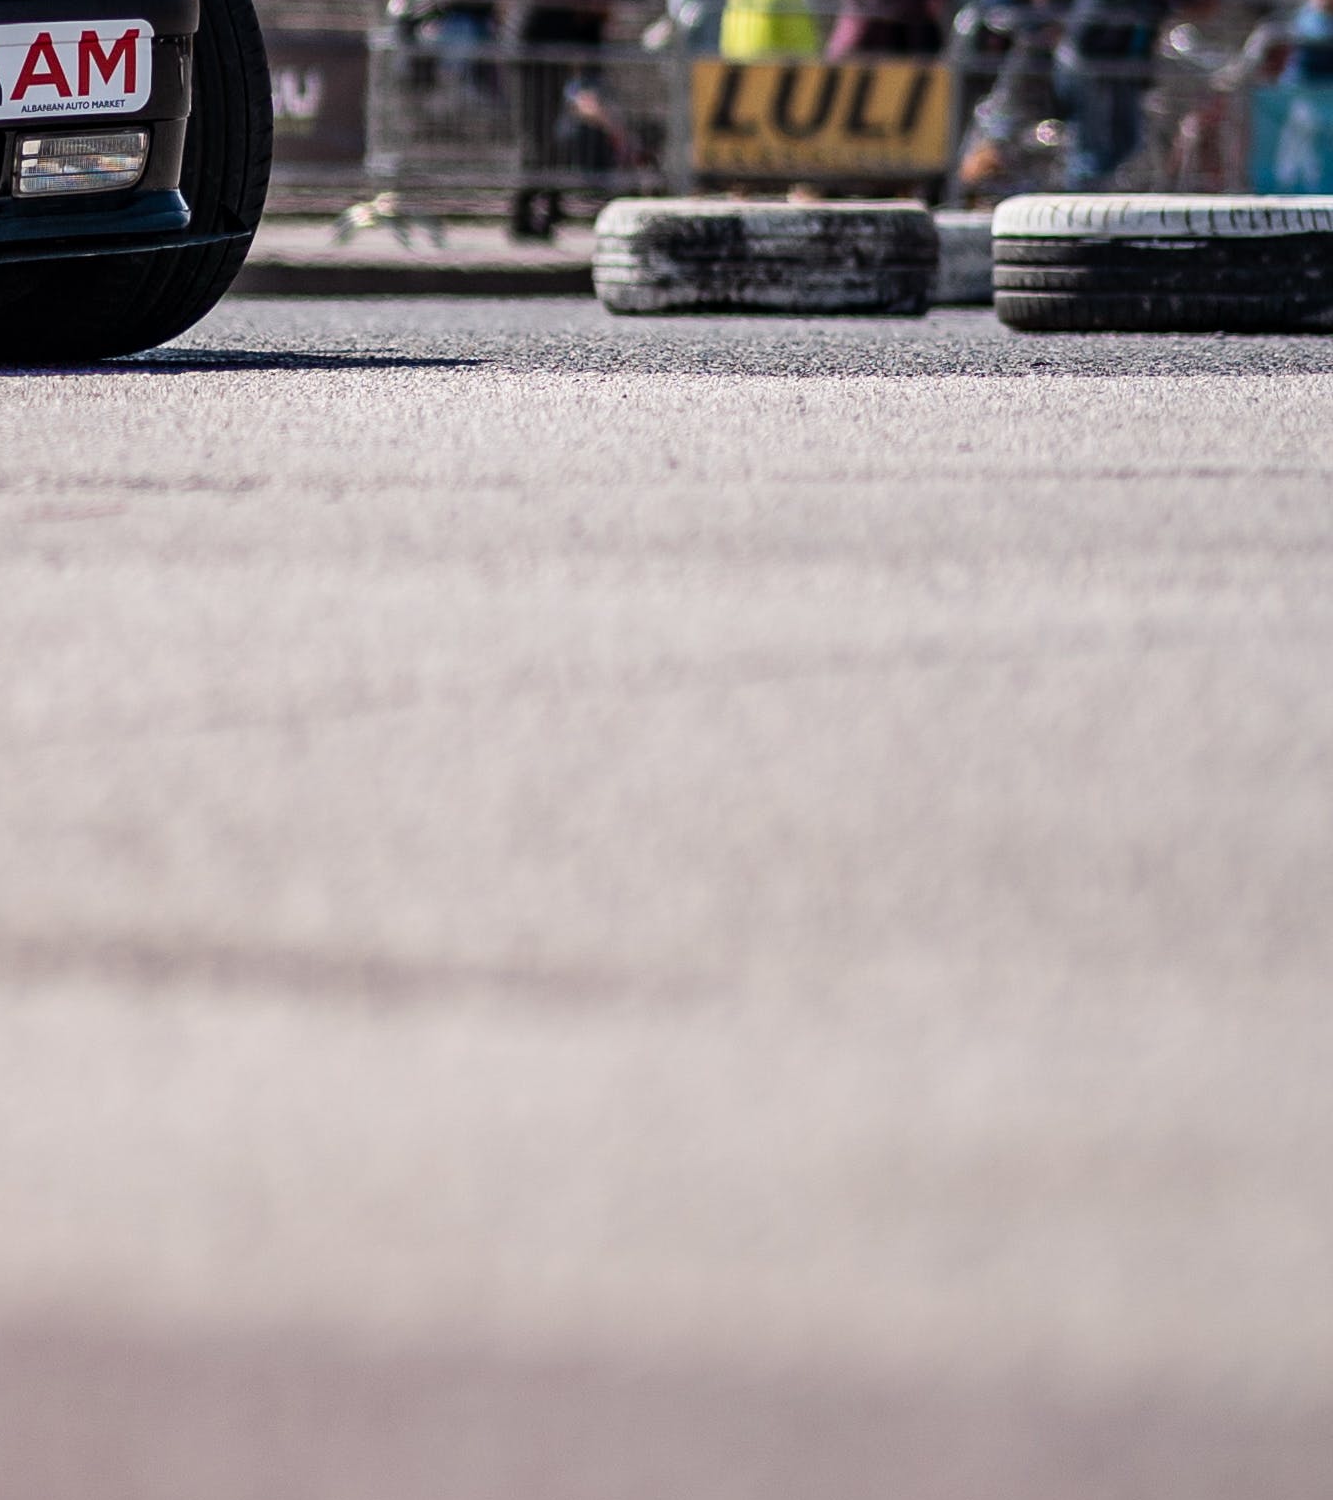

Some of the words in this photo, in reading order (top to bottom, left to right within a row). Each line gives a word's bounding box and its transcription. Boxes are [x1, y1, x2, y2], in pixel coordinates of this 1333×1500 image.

[21, 103, 65, 114] ALBANIAN
[65, 101, 90, 111] AUTO
[91, 99, 126, 109] MARKET
[711, 64, 933, 138] LULI
